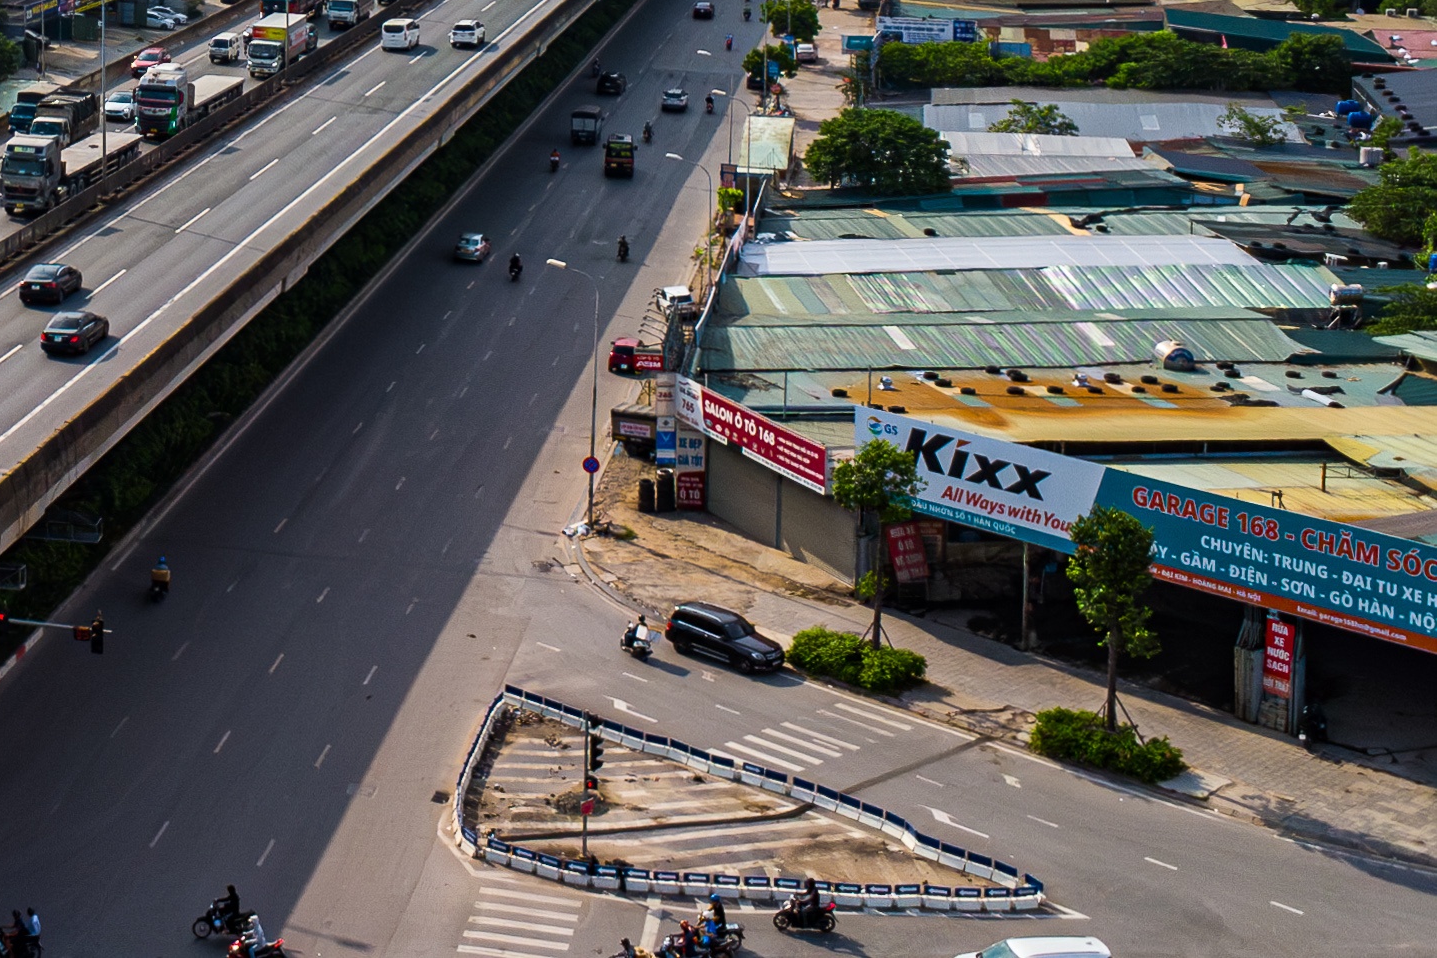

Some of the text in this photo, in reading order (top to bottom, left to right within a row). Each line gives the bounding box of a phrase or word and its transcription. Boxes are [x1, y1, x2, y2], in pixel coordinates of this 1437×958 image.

[704, 399, 733, 428] SALON
[735, 412, 742, 428] Ô
[744, 418, 756, 436] TÔ
[759, 427, 775, 446] 168
[884, 423, 898, 436] GS
[905, 427, 1052, 501] Kixx
[941, 485, 1072, 533] All Ways with You
[993, 521, 1016, 535] QUỐC
[1132, 486, 1230, 529] GARAGE
[1236, 512, 1279, 541] 168
[1300, 528, 1380, 567] CHĂM
[1386, 548, 1437, 582] SÓC
[1180, 550, 1216, 572] GẦM
[1229, 564, 1268, 586] ĐIỆN
[1281, 578, 1315, 598] SƠN
[1329, 590, 1353, 608] GÒ
[1358, 597, 1394, 619] HÀN
[1409, 611, 1437, 633] NỘ
[1201, 535, 1268, 564] CHUYÊN:
[1273, 552, 1328, 579] TRUNG
[1341, 569, 1372, 592] ĐẠI
[1376, 578, 1397, 597] TU
[1402, 586, 1422, 604] XE
[1274, 636, 1285, 647] XE
